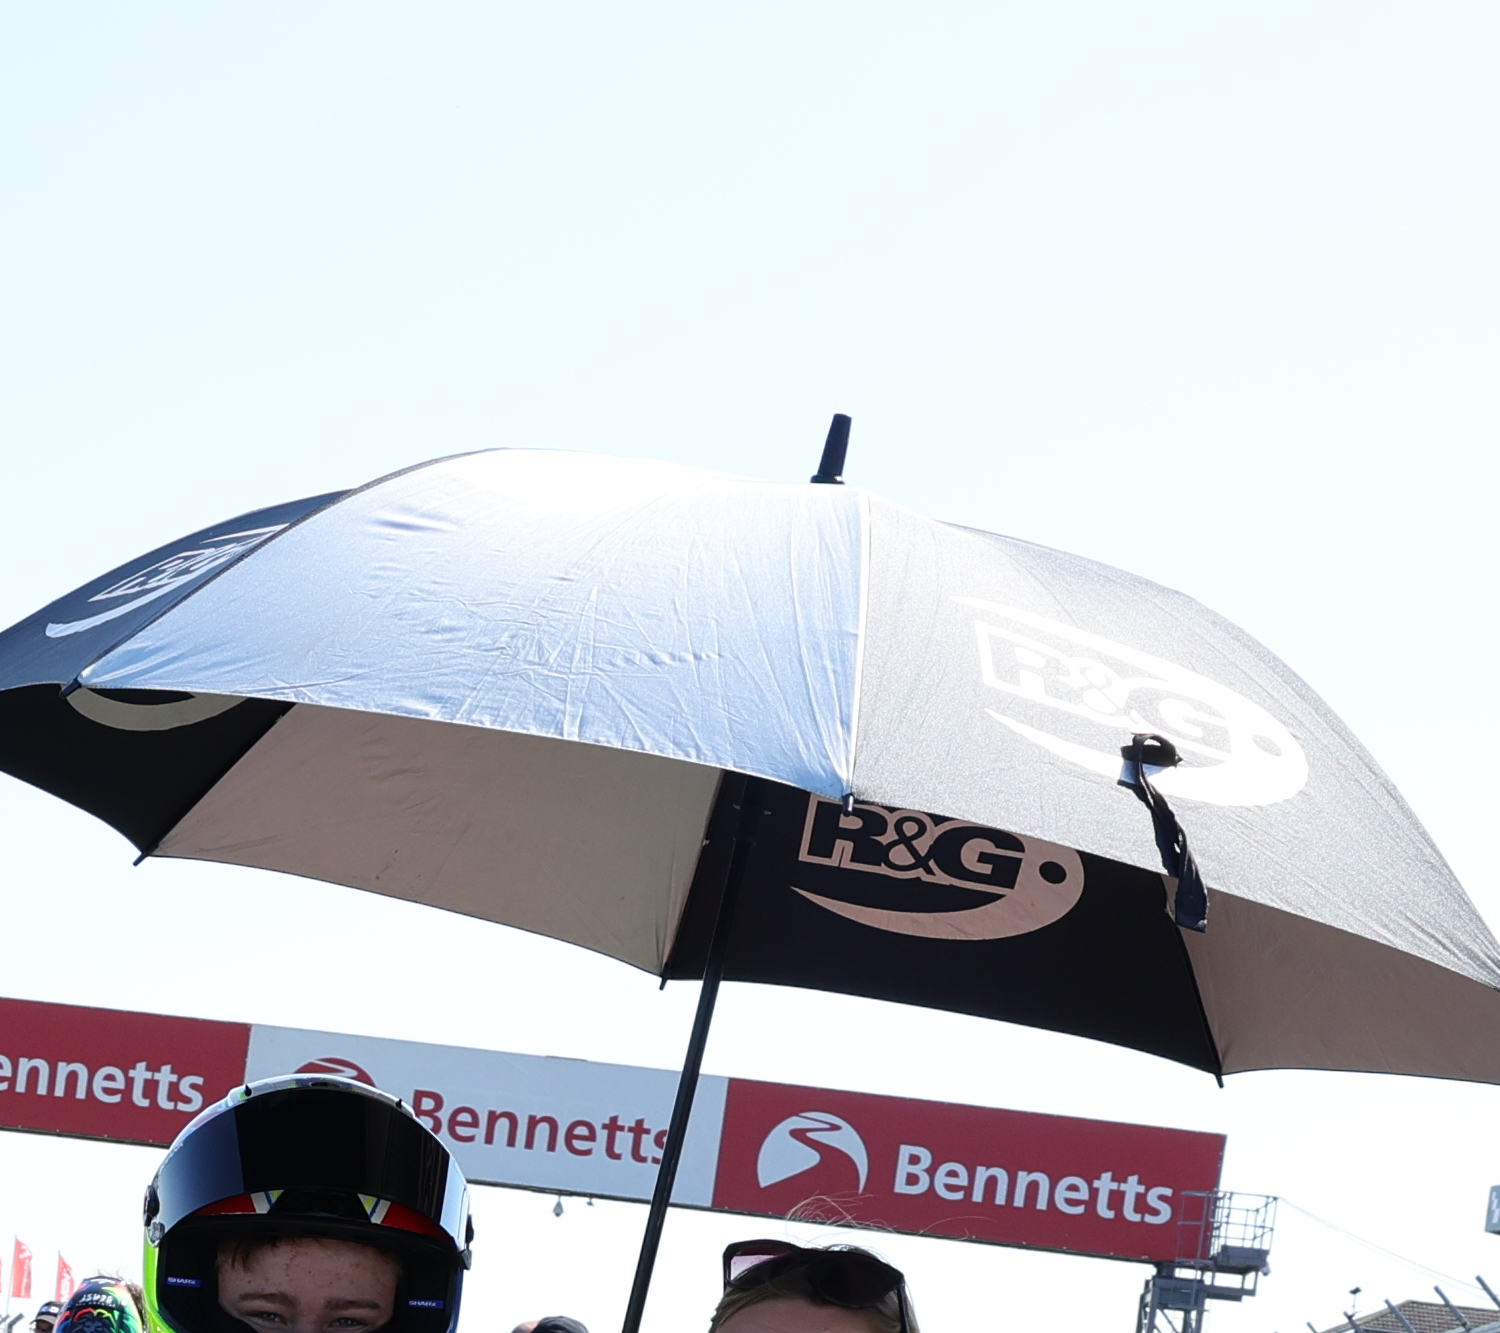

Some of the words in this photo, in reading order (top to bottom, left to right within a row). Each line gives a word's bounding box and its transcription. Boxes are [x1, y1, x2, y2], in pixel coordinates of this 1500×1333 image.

[807, 800, 1026, 890] R&G
[410, 1088, 669, 1167] Bennetts
[891, 1143, 1175, 1226] Bennetts
